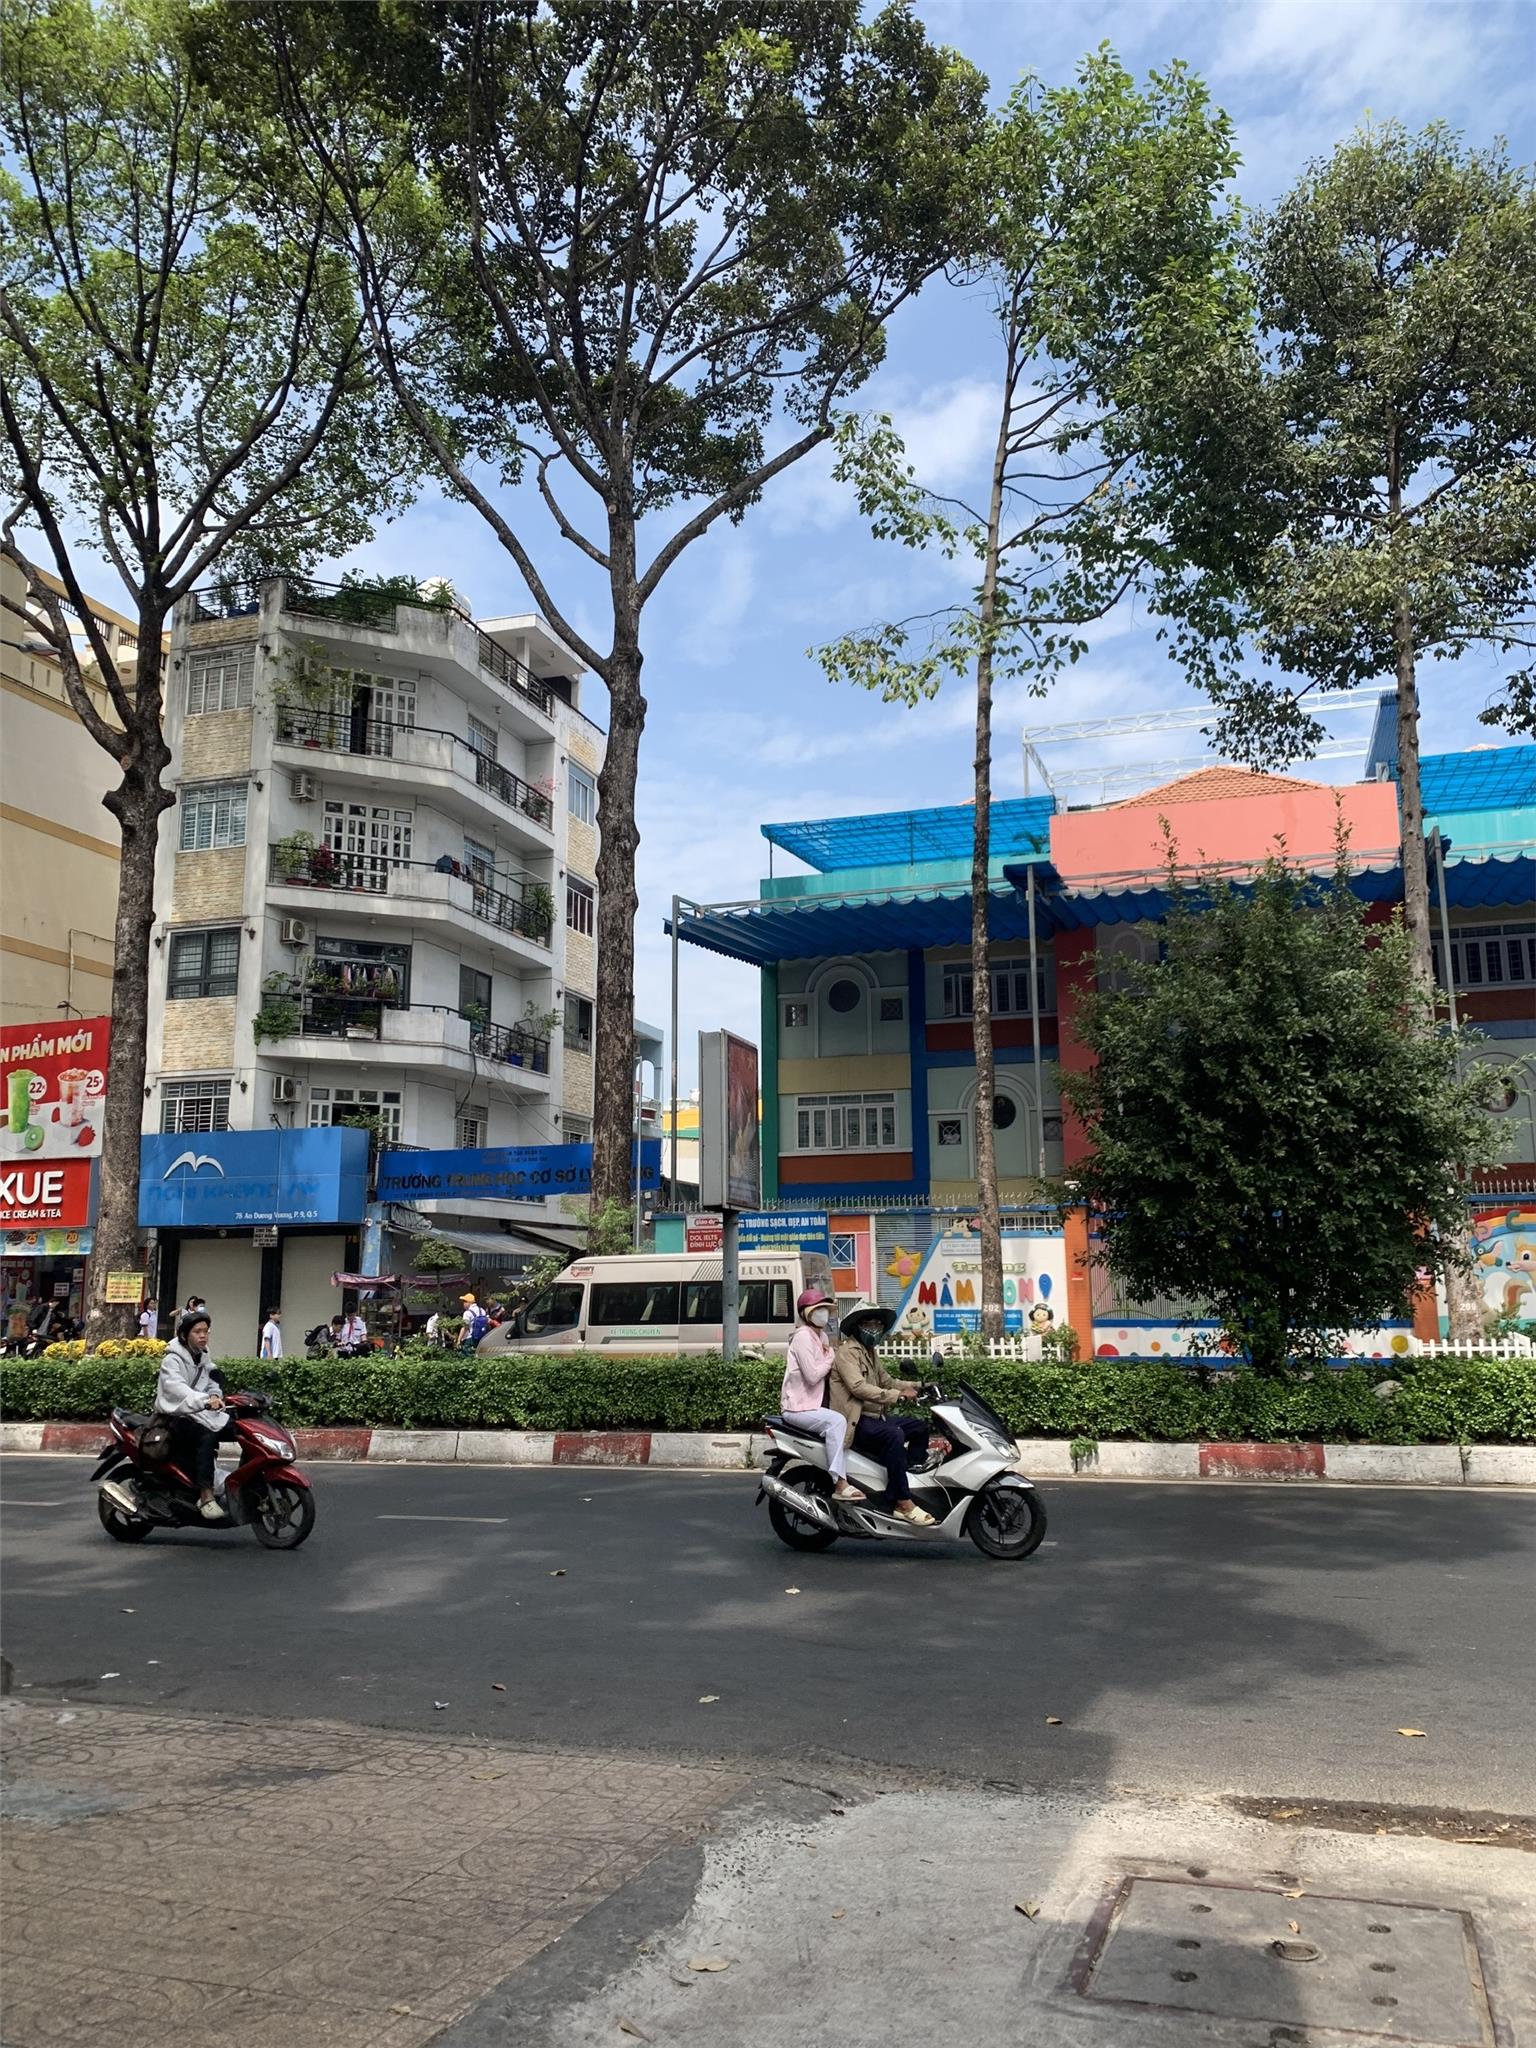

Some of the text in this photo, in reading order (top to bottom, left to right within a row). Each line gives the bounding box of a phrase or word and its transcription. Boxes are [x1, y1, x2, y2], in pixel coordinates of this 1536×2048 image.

[11, 1033, 55, 1061] PHẨM
[57, 1028, 93, 1055] MỚI
[0, 1170, 65, 1206] XUE
[382, 1172, 441, 1190] TRƯỜNG
[13, 1209, 39, 1219] CREAM
[741, 1265, 790, 1275] LUXURY
[952, 1261, 1026, 1274] Trng
[918, 1272, 1035, 1307] MẦM ON
